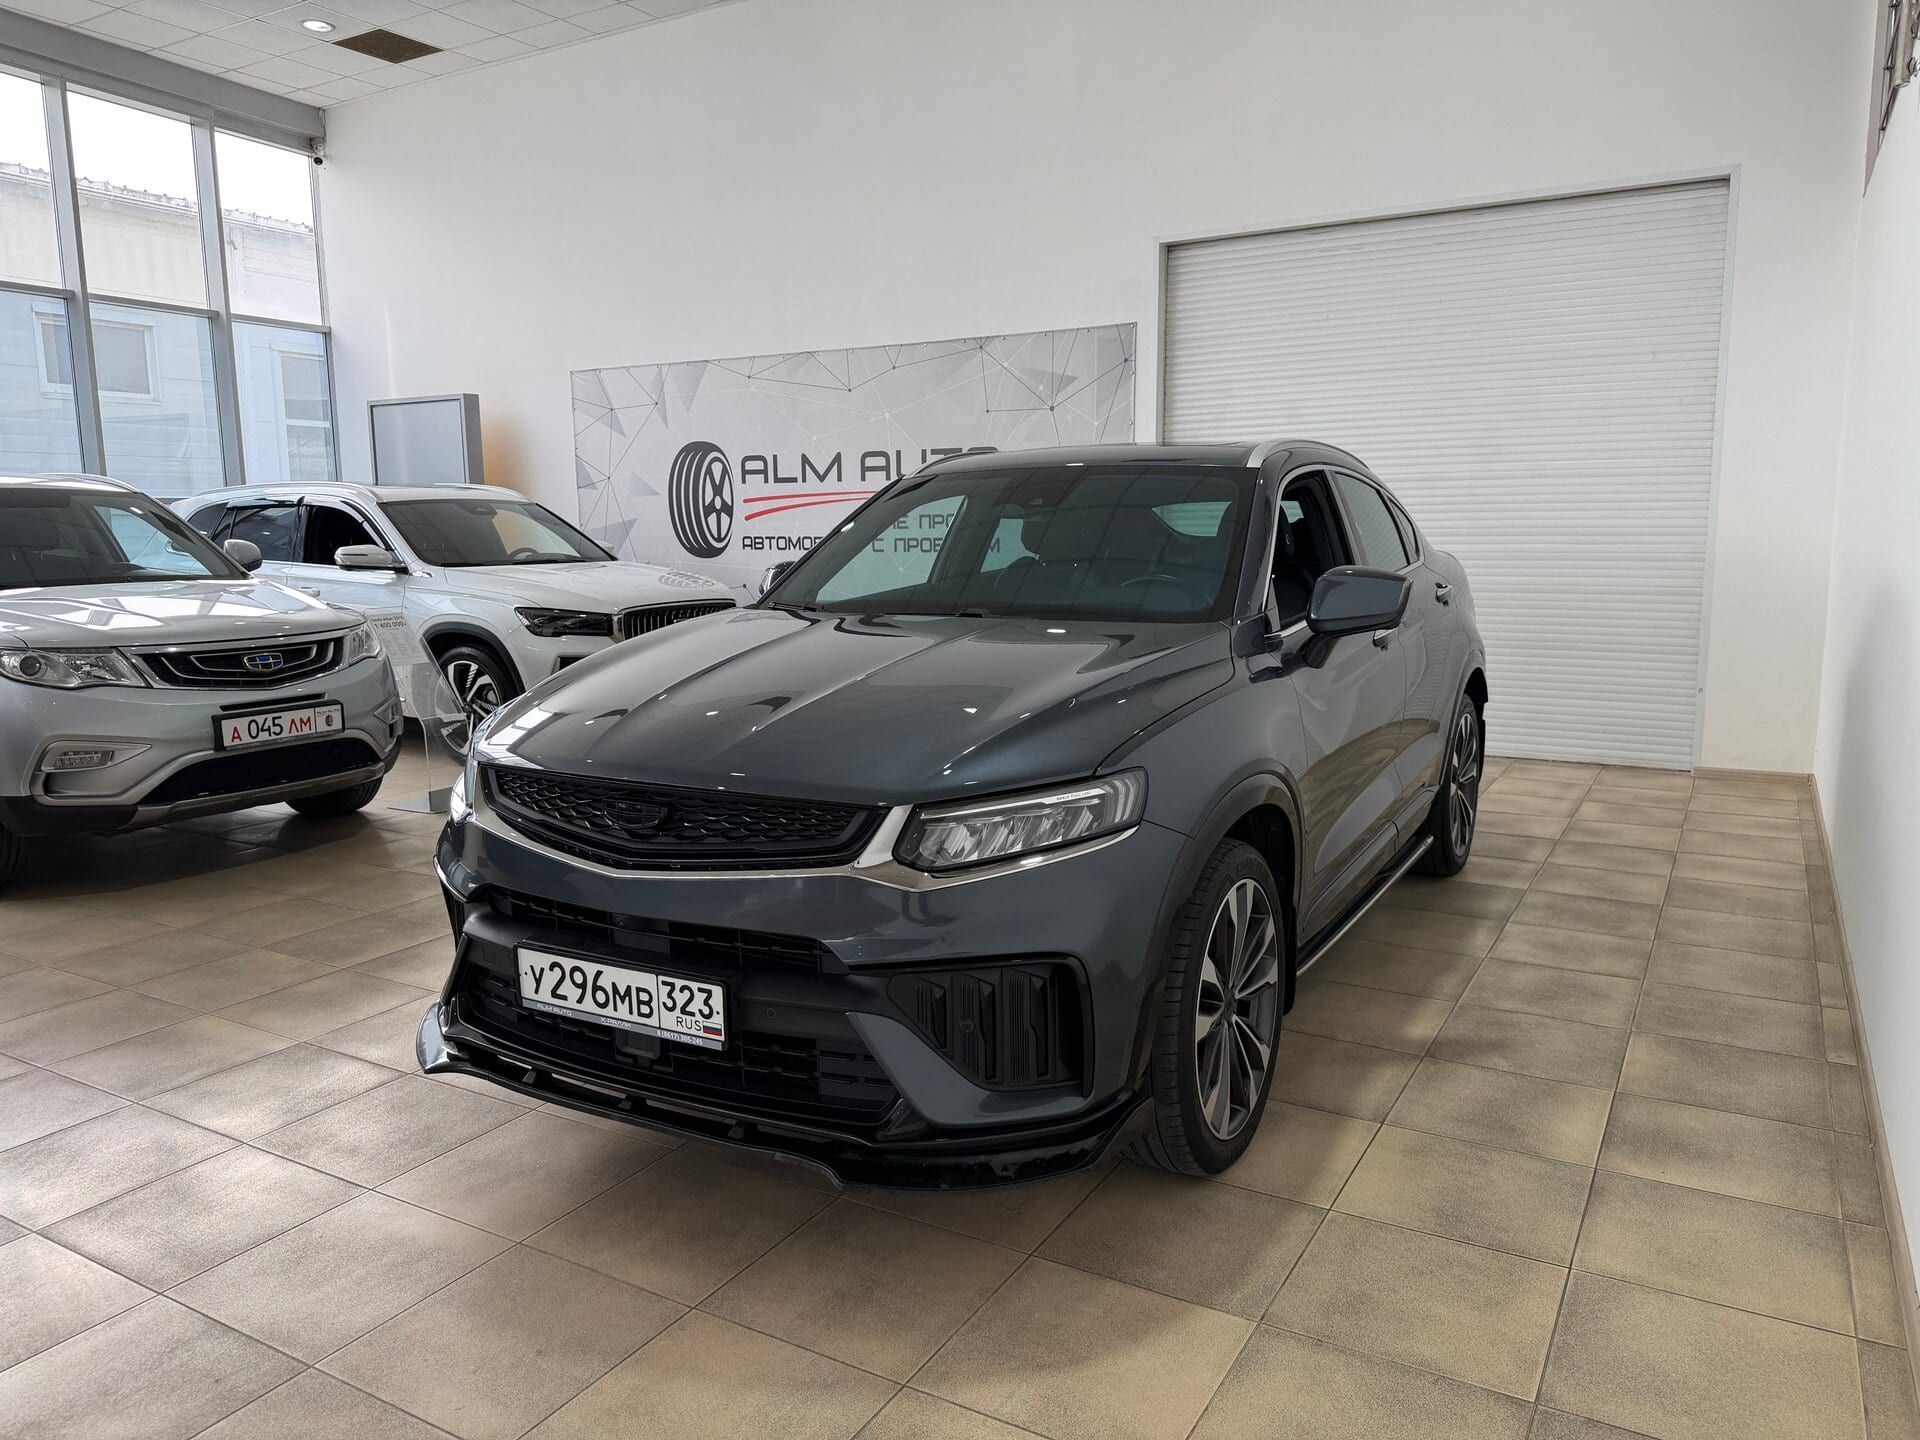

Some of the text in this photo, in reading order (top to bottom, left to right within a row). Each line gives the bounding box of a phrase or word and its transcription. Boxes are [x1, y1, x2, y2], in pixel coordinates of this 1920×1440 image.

[741, 446, 999, 484] ALM AUT
[872, 537, 885, 553] С
[247, 715, 284, 740] 045
[661, 980, 714, 1020] 323
[676, 1016, 702, 1031] RUS
